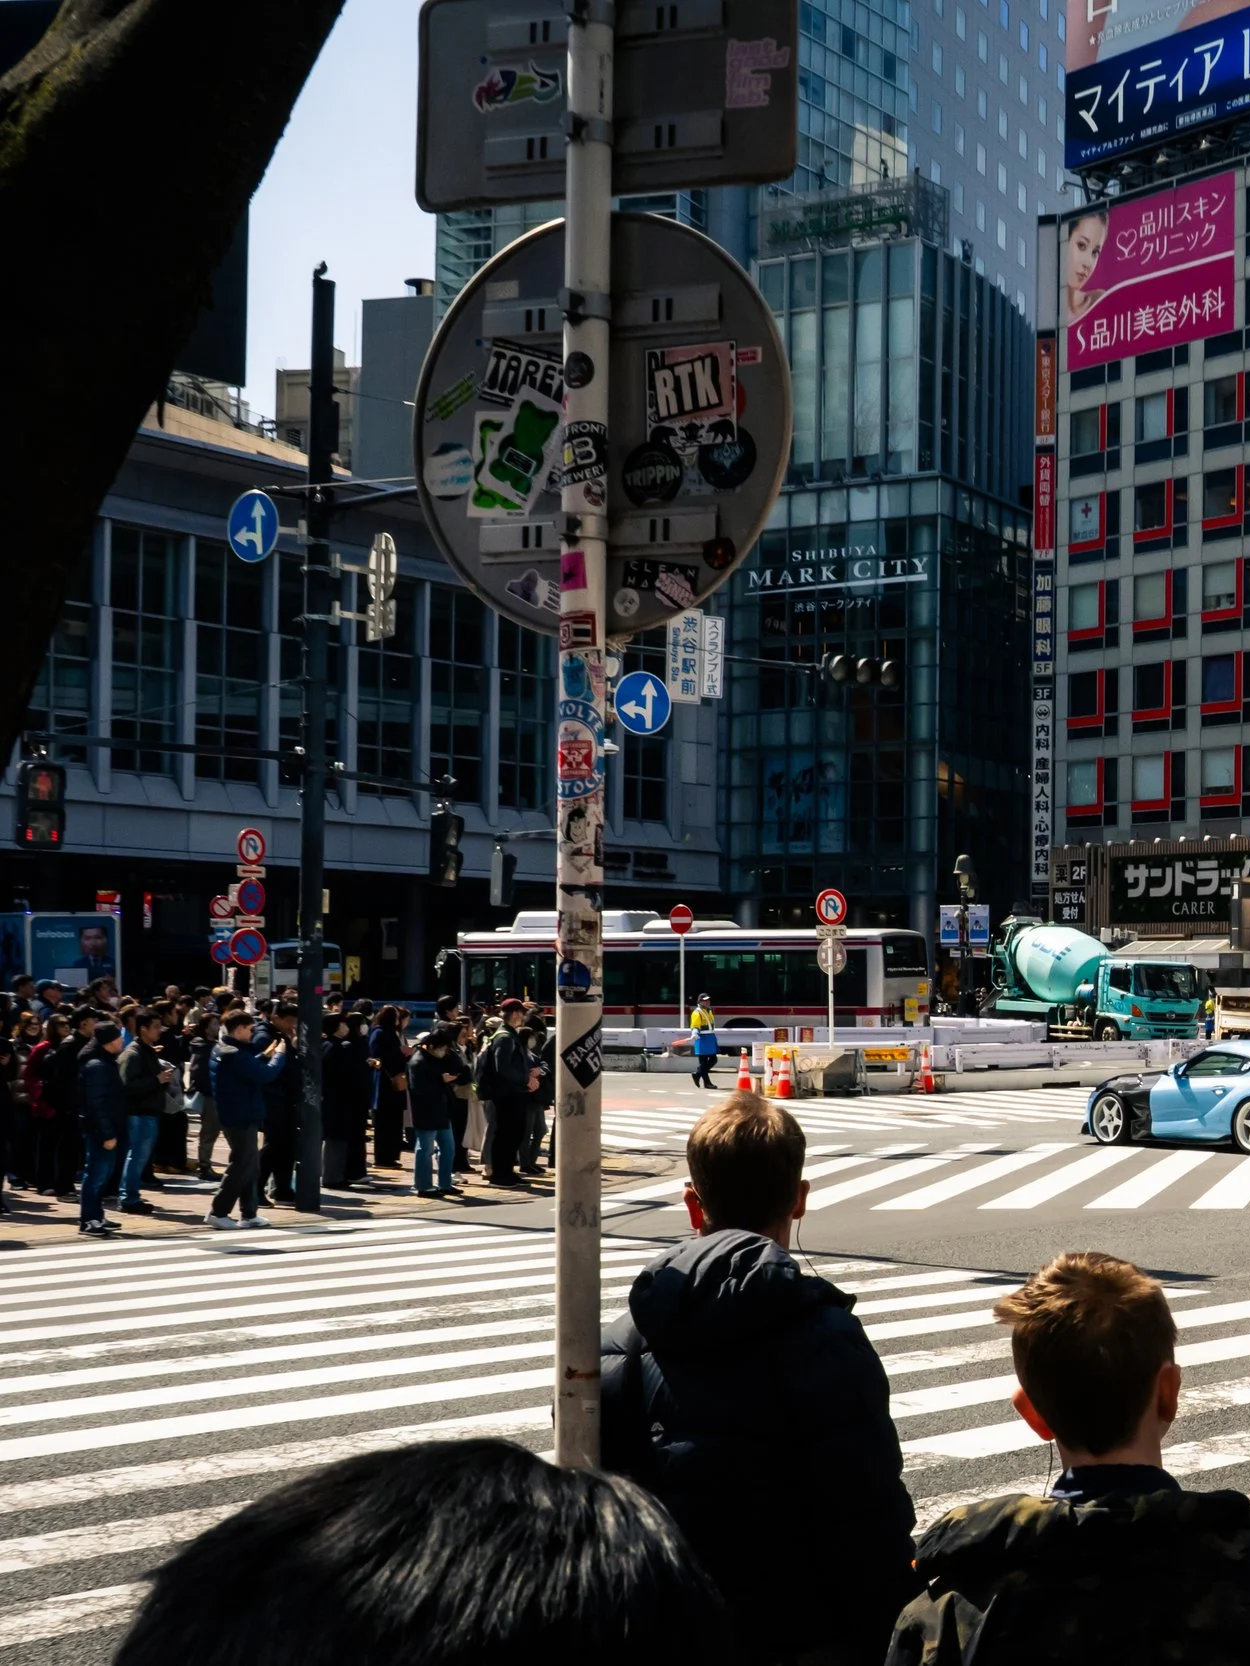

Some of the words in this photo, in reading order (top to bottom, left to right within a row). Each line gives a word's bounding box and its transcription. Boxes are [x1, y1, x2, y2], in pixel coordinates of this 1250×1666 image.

[1074, 38, 1225, 133] マイティア
[1139, 192, 1227, 229] 品川スキン
[1139, 224, 1217, 265] クリニック
[1089, 287, 1225, 351] 品川美容外科
[654, 355, 720, 419] RTK
[561, 463, 606, 487] REWERY
[625, 464, 681, 488] TRIPPIN
[791, 544, 877, 563] SHIBUYA
[747, 564, 839, 589] MARK
[852, 557, 929, 579] CITY
[681, 616, 698, 696] 渋谷駅前
[706, 620, 719, 695] スクランブル式
[1035, 663, 1051, 673] 5F
[1035, 688, 1051, 700] 3F
[1035, 725, 1050, 751] 内科
[1055, 864, 1068, 882] 薬
[1072, 866, 1087, 882] 2F
[1054, 891, 1087, 905] 処方せん
[1171, 901, 1216, 916] CARER
[1062, 906, 1079, 919] 受付
[818, 928, 846, 937] ここまで
